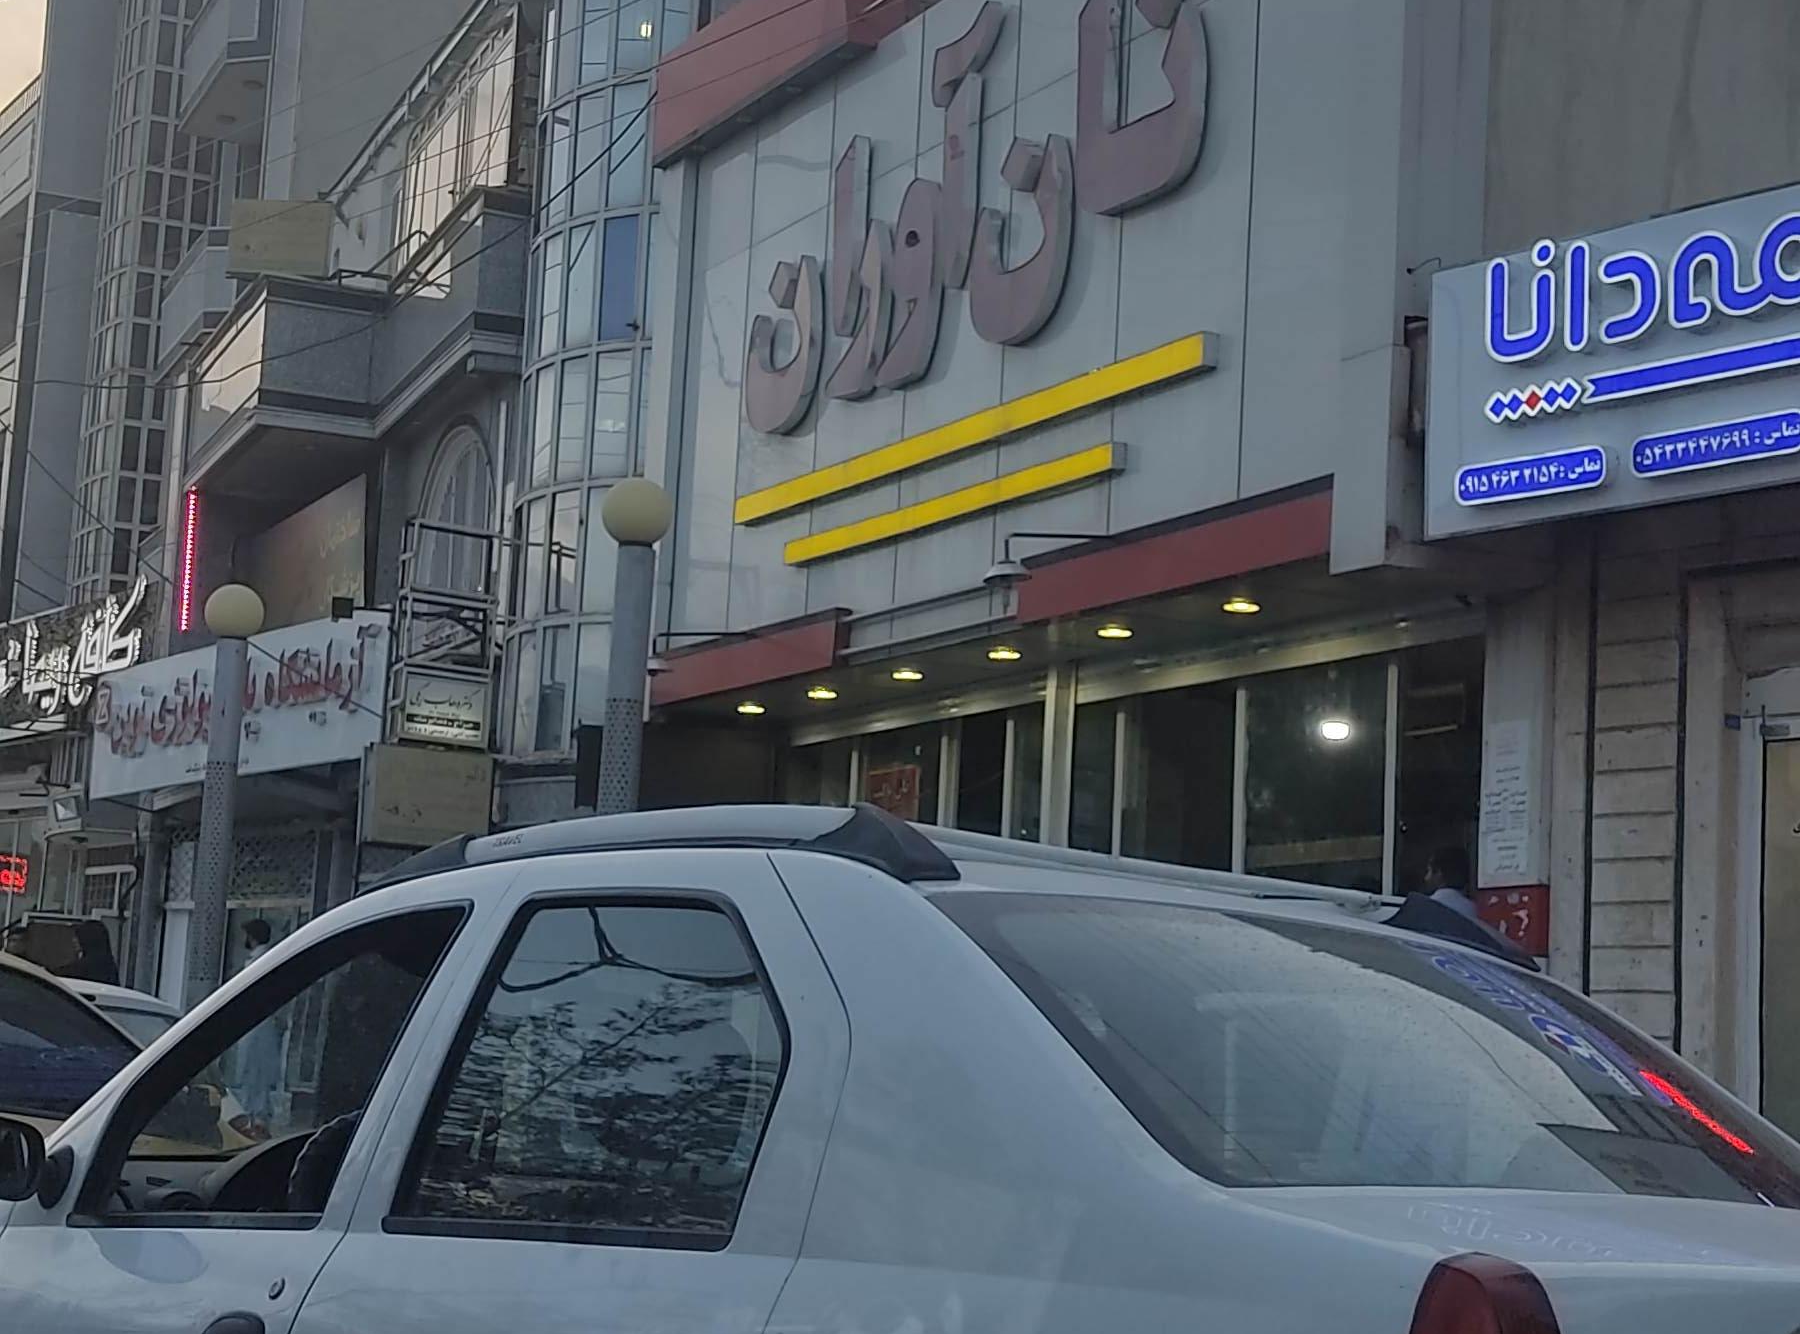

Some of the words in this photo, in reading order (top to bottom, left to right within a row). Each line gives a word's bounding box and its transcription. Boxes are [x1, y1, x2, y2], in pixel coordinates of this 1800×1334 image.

[745, 0, 1005, 436] آوران
[1485, 238, 1661, 363] دانا
[110, 683, 151, 759] نوین
[264, 623, 383, 725] آزمایشگاه
